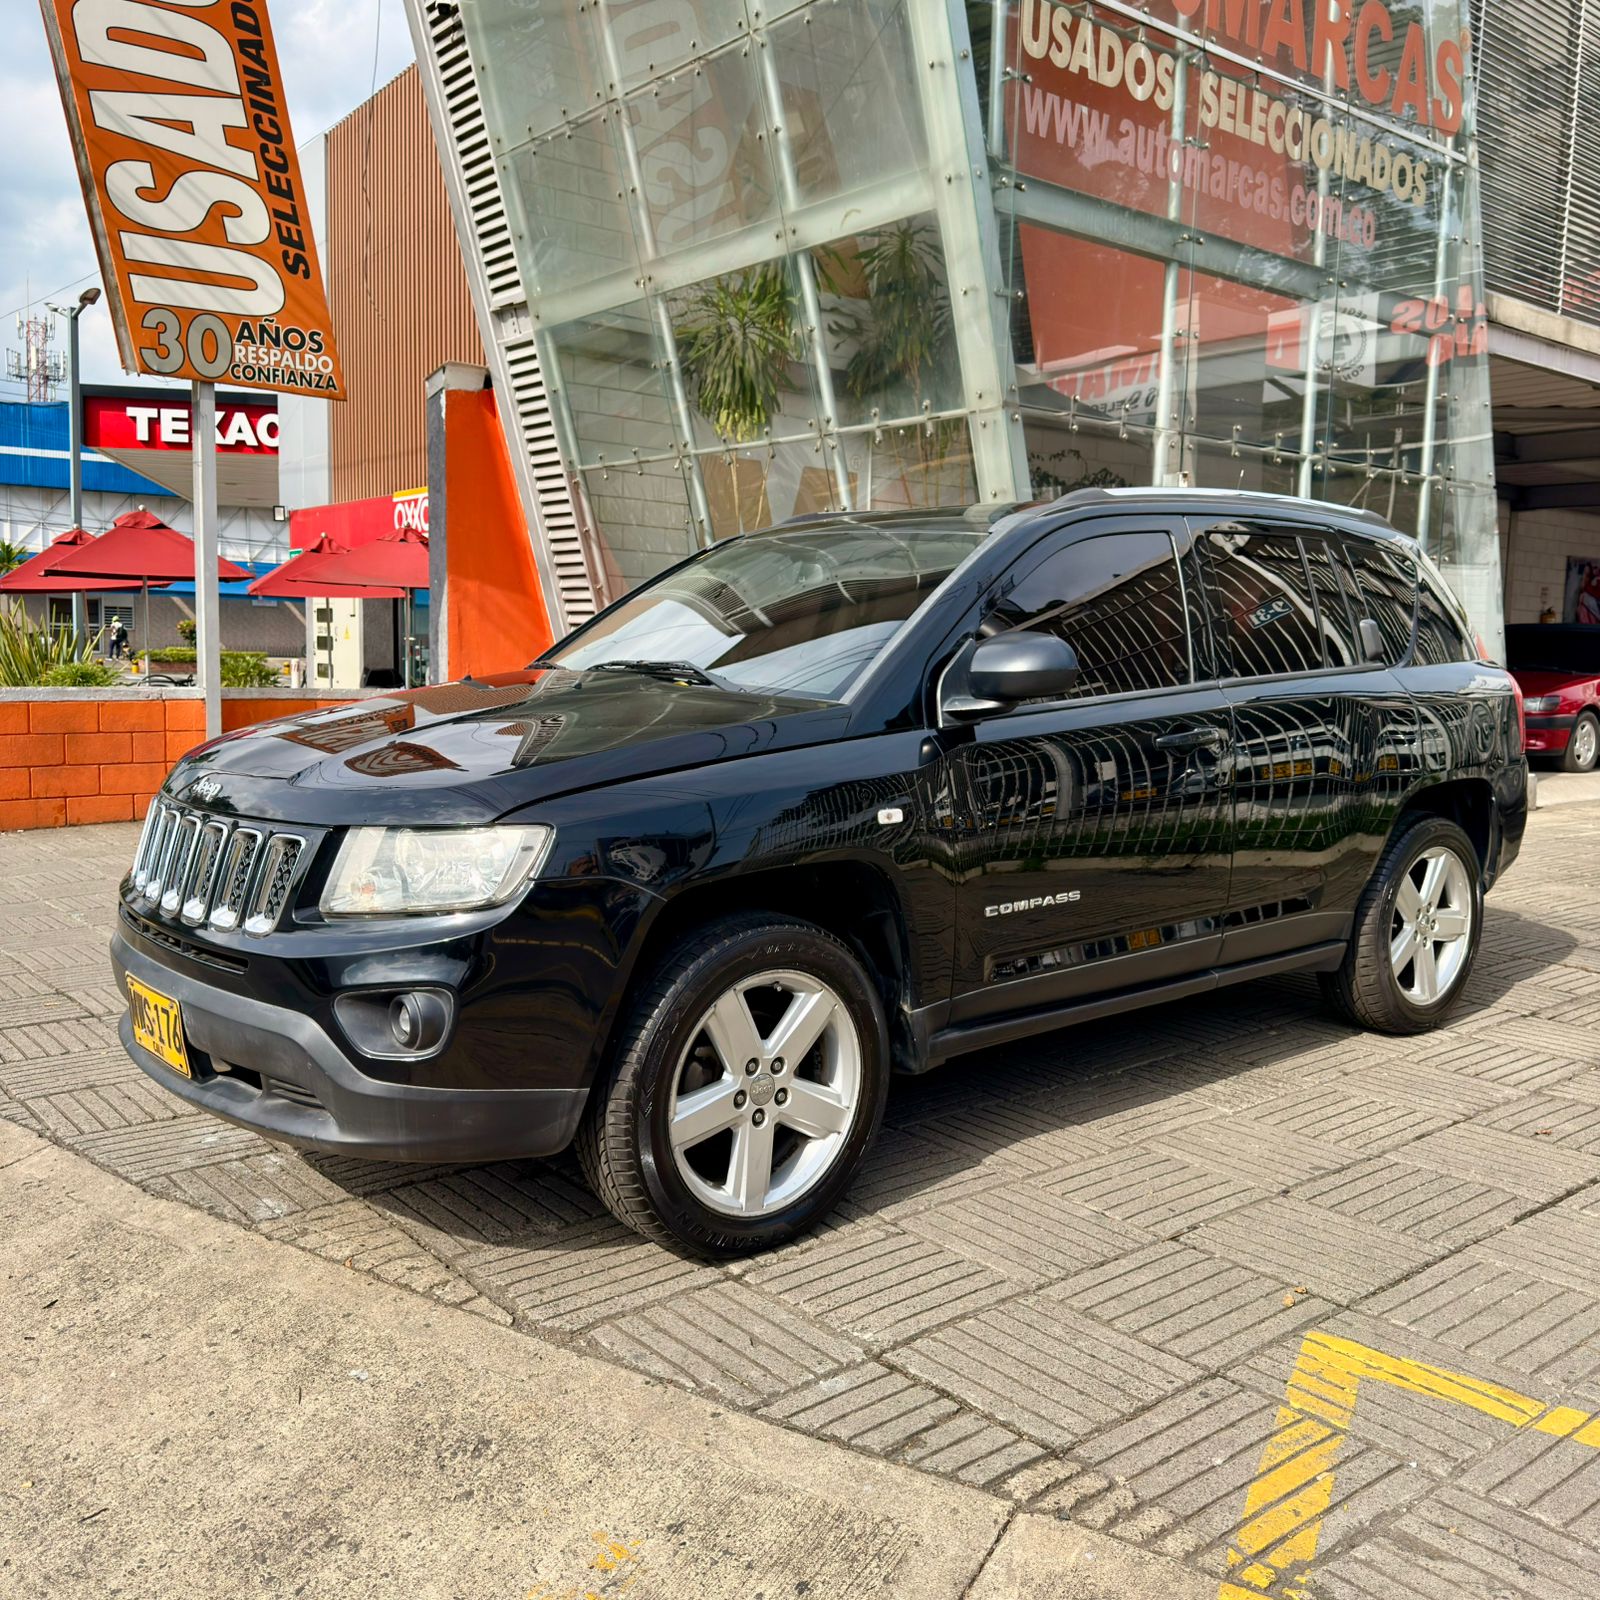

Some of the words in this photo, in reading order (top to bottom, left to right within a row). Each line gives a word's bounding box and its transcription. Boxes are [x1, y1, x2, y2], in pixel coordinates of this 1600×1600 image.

[1022, 0, 1175, 111] USADOS
[1201, 71, 1427, 207] SELECCIONADOS
[1172, 0, 1463, 138] ARCAS
[71, 0, 285, 317] USAD
[231, 0, 310, 280] SELECCINAD
[1024, 85, 1375, 249] www.automarcas.com.co
[139, 307, 233, 379] 30
[235, 318, 324, 354] AÑOS
[230, 363, 338, 391] CONFIANZA
[234, 345, 334, 374] RESPALDO
[193, 776, 222, 802] Jeep
[984, 890, 1081, 917] COMPASS
